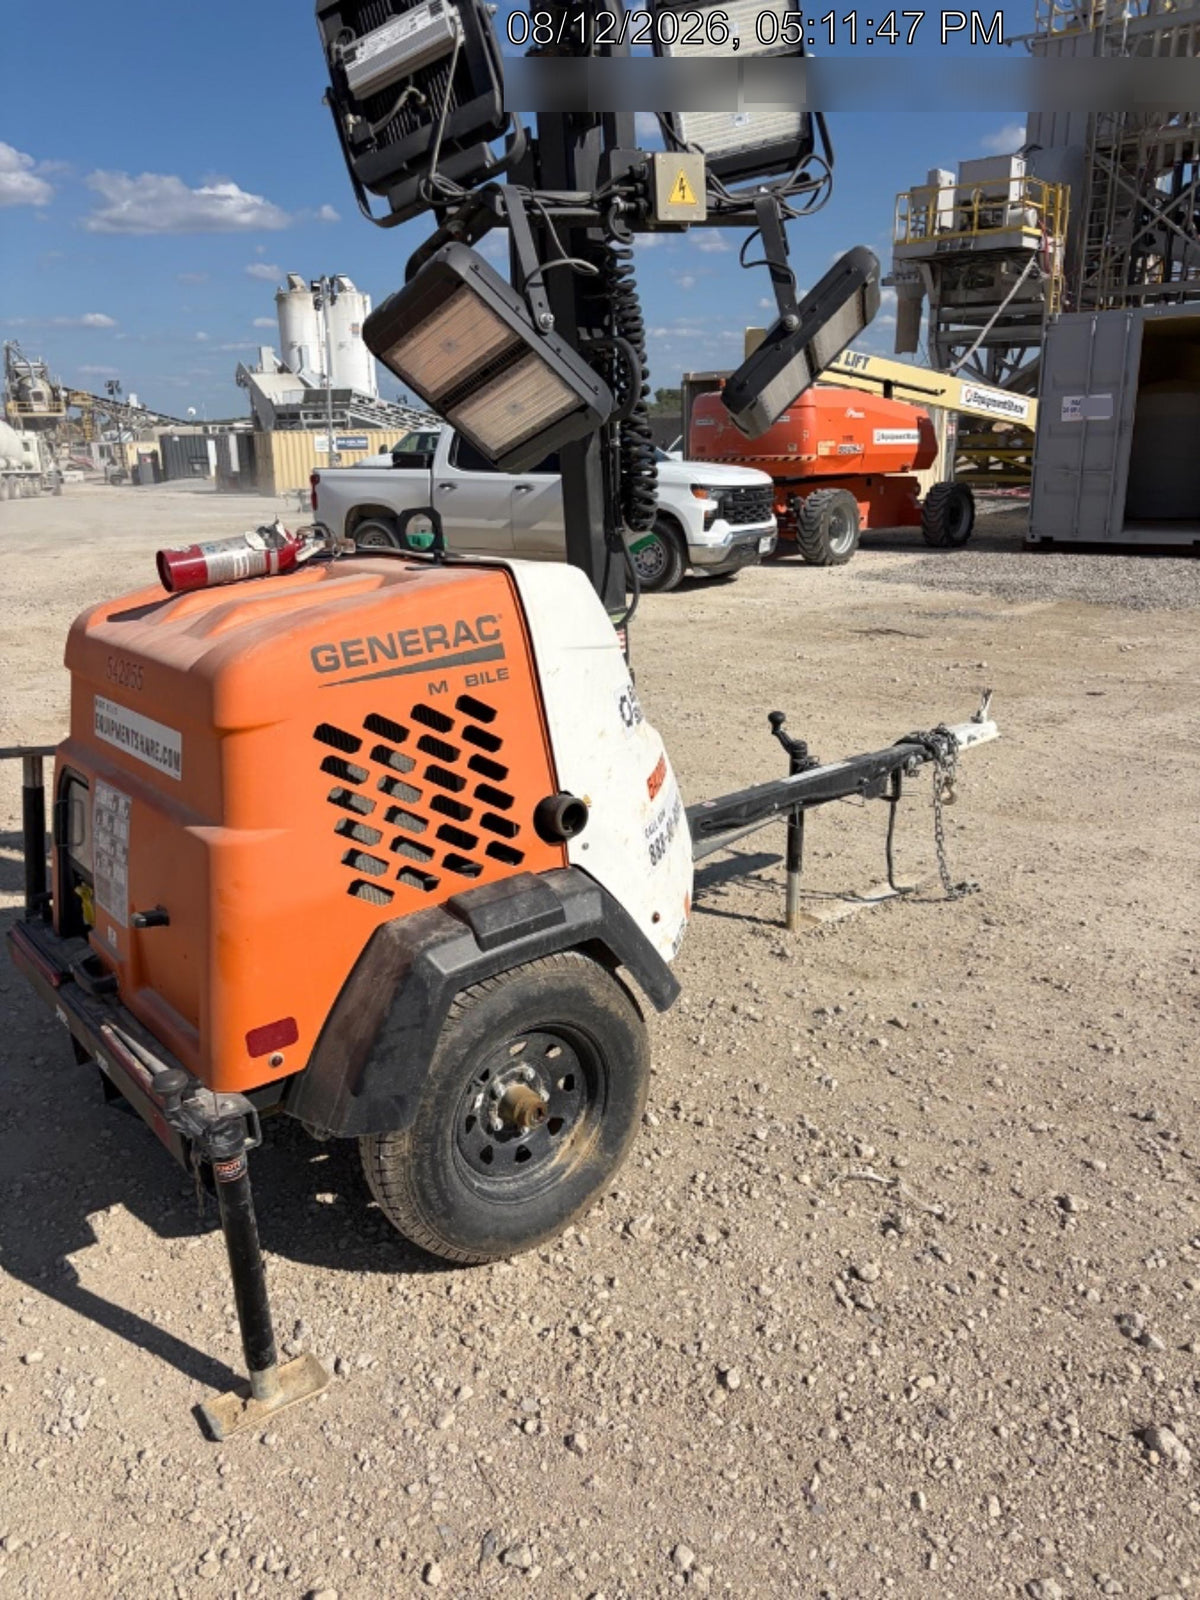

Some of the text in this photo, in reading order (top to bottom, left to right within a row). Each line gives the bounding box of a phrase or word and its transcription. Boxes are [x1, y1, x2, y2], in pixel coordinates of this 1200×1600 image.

[844, 351, 870, 370] LIFT
[310, 614, 503, 673] GENERAC
[95, 712, 181, 773] EQUIPMENTSHARE.COM
